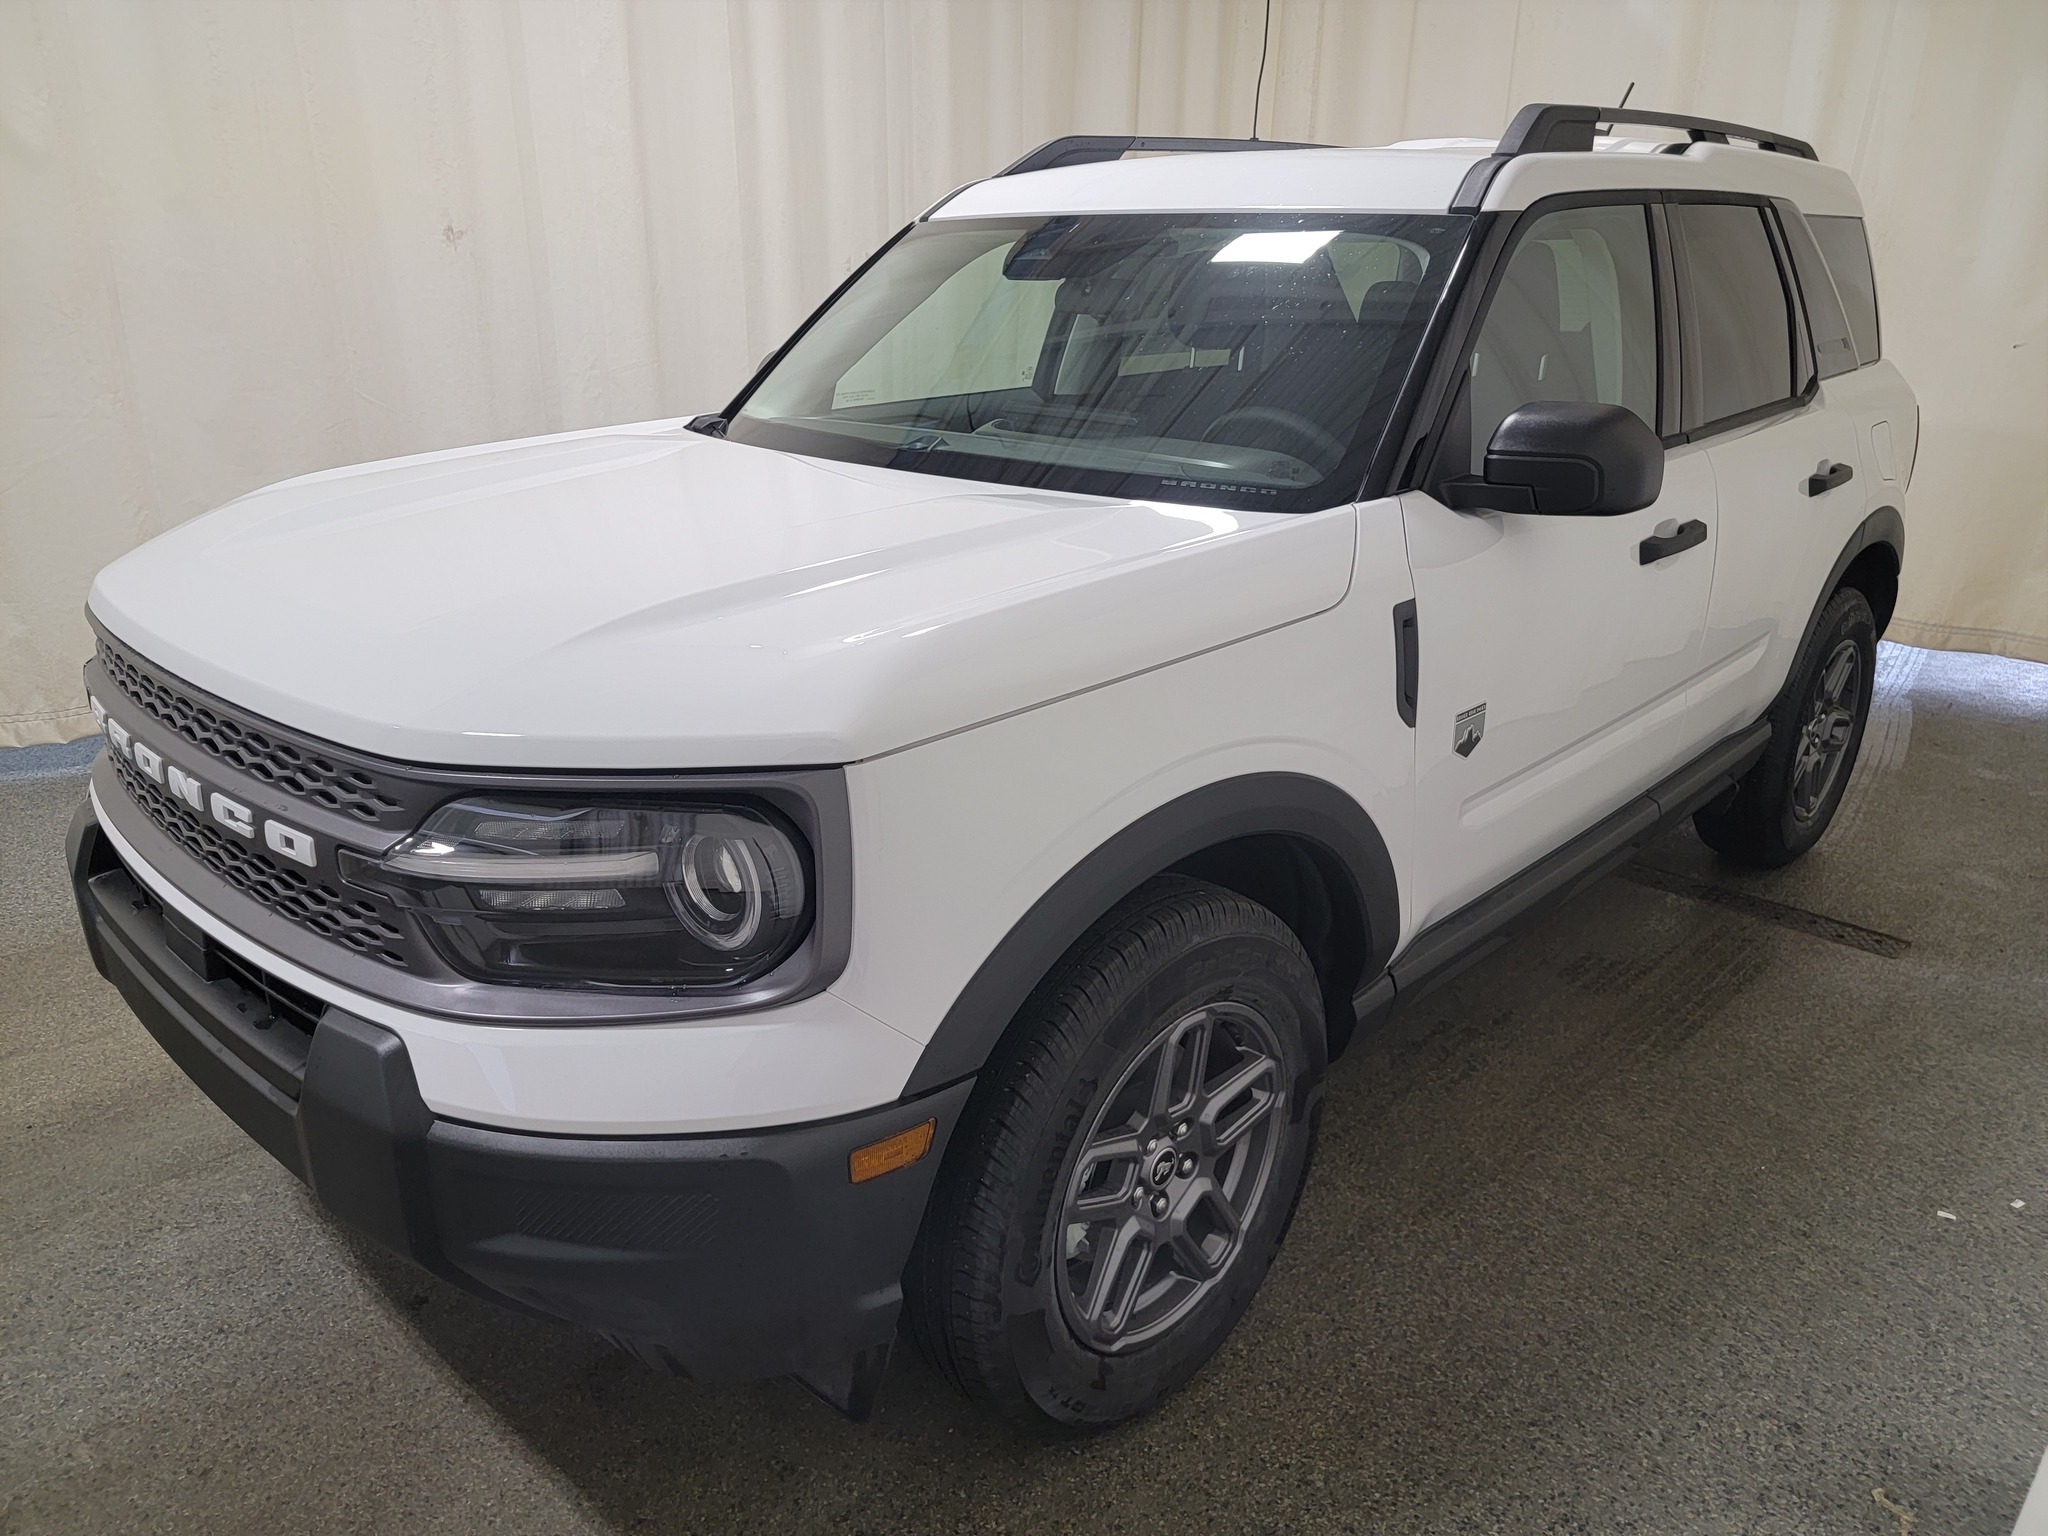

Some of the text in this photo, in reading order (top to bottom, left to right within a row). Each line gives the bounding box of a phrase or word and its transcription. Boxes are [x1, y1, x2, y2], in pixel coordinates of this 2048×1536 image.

[1161, 479, 1278, 496] BRONCO
[1468, 704, 1486, 717] BEND
[90, 696, 317, 867] BRONCO
